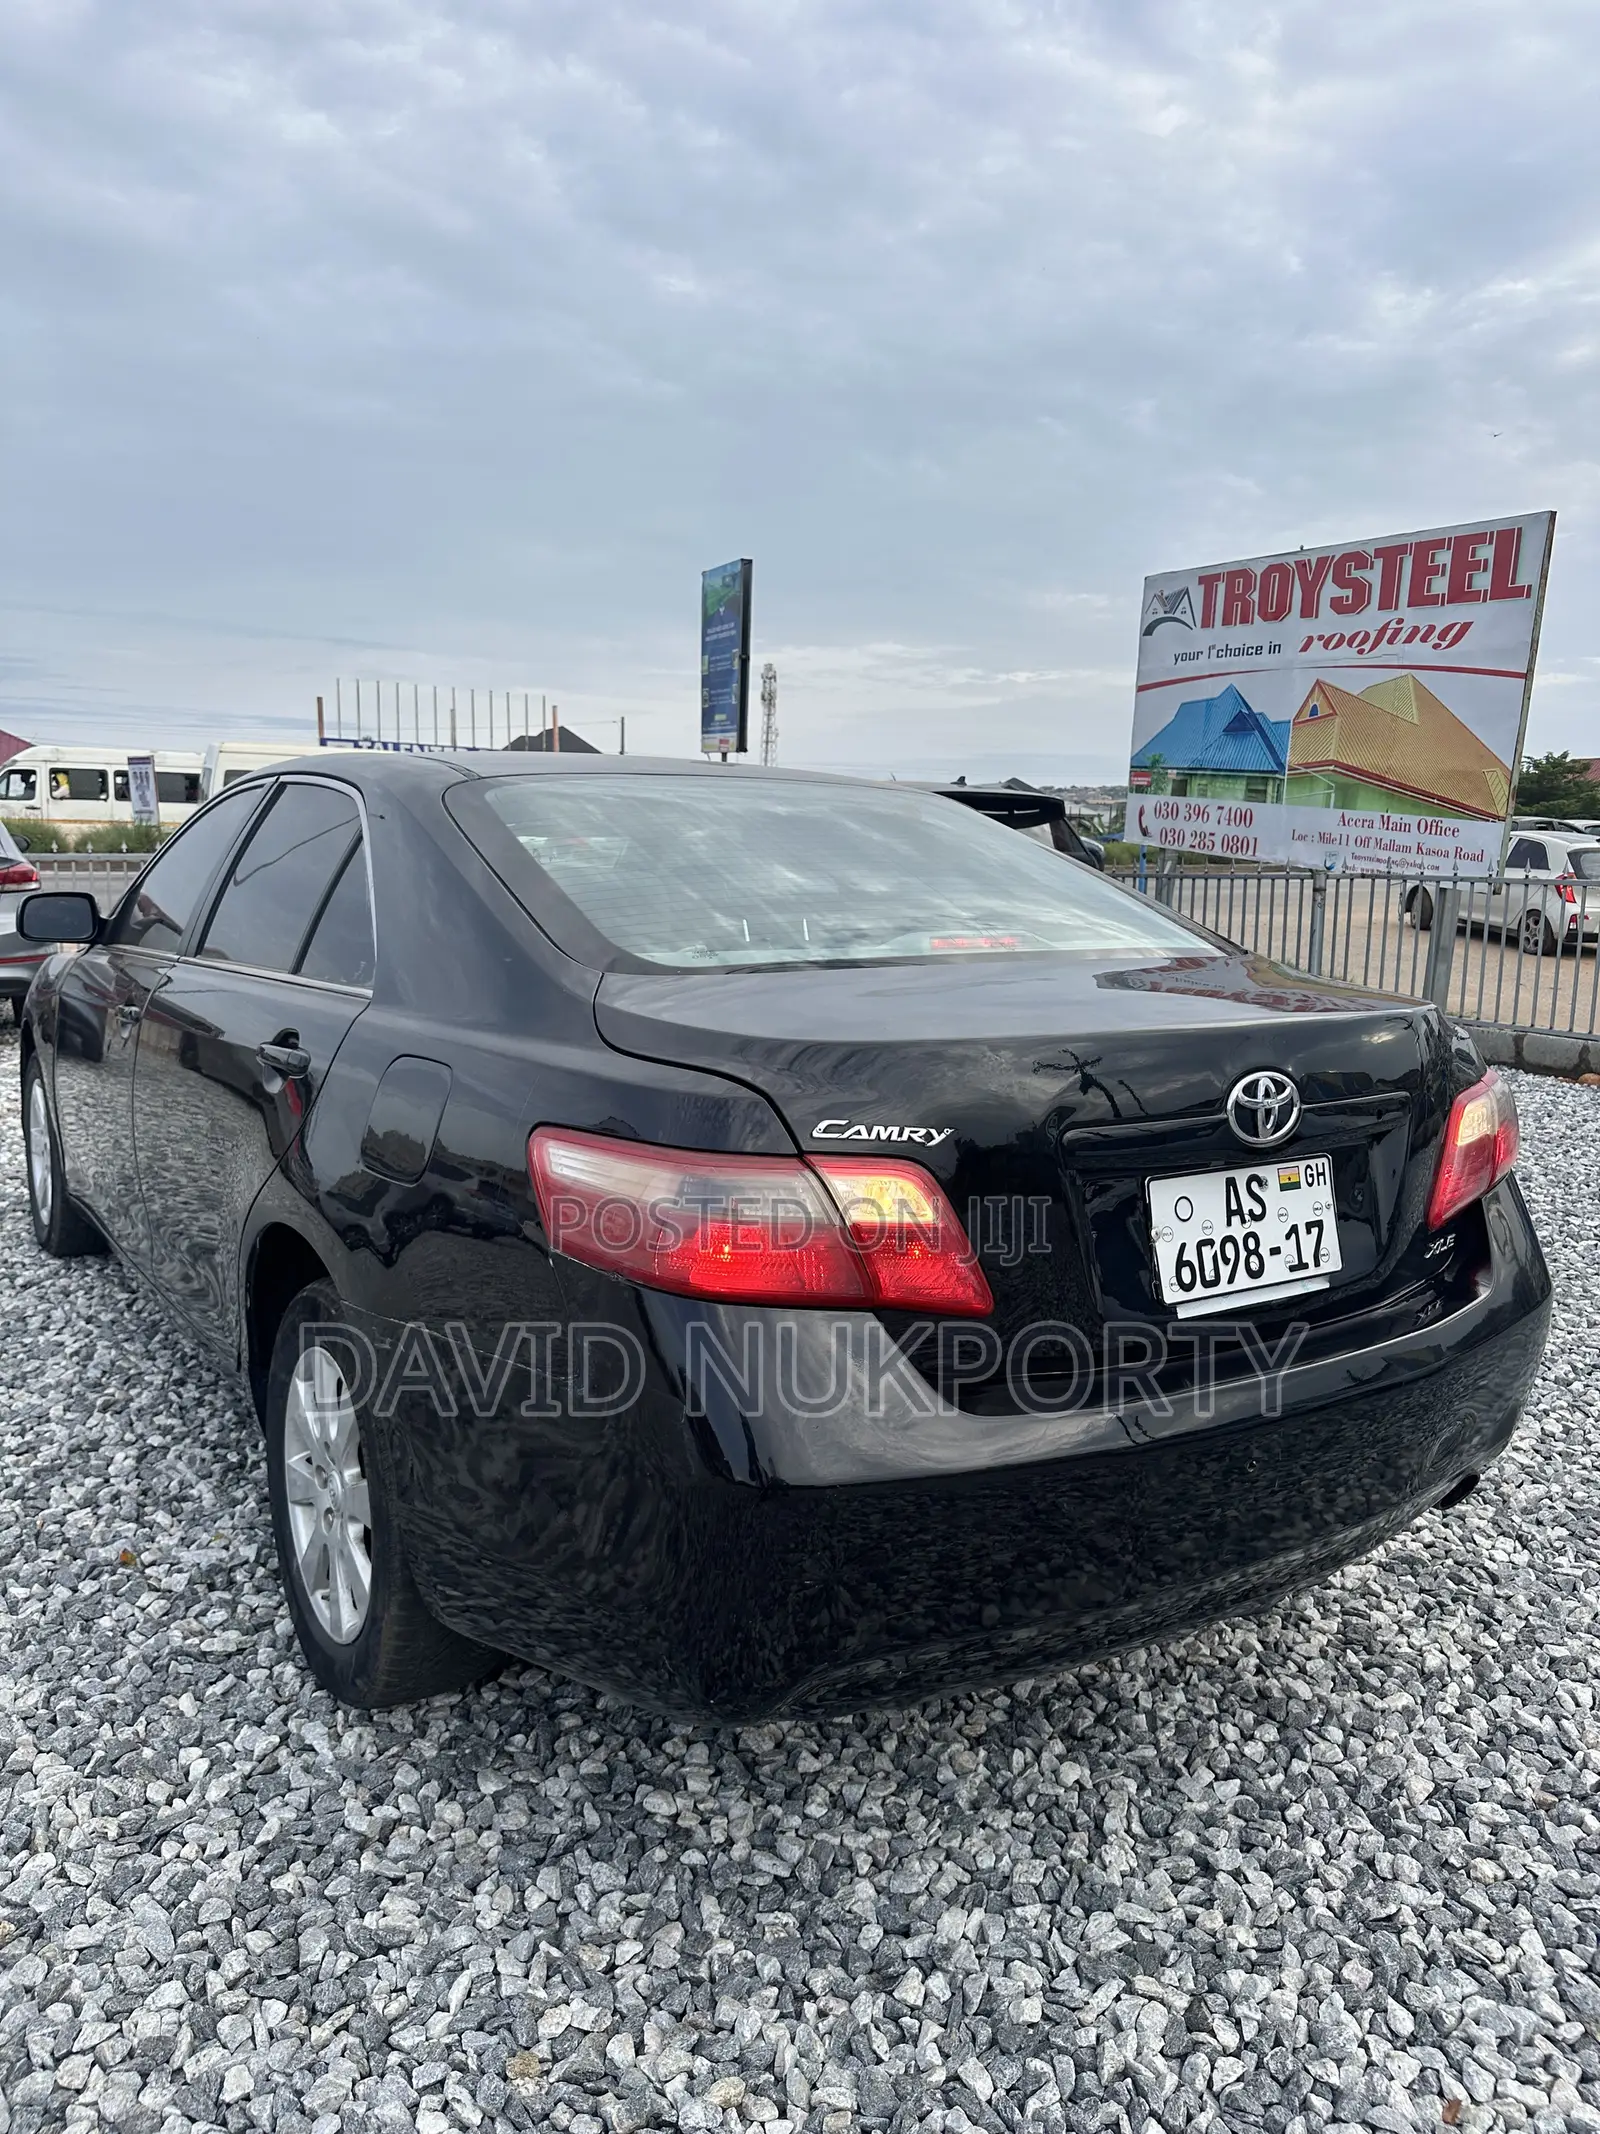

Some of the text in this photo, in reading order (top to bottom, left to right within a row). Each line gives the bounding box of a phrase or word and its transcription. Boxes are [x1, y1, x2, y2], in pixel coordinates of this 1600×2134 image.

[1197, 527, 1533, 629] TROYSTEEL
[1173, 650, 1204, 666] your
[1216, 643, 1264, 659] choice
[1267, 640, 1282, 655] in
[1299, 617, 1474, 655] roofing
[1153, 800, 1254, 829] 030 396 7400
[1336, 811, 1461, 838] Accra Main Office
[1159, 826, 1259, 857] 030 285 0801
[1291, 829, 1309, 843] Loc
[1354, 835, 1371, 849] Off
[1373, 837, 1412, 855] Mallam
[1415, 842, 1450, 859] Kasoa
[1453, 846, 1485, 863] Road
[811, 1118, 956, 1147] CAMRY
[1224, 1162, 1327, 1228] AS GH
[1175, 1219, 1325, 1293] 6098-17
[1424, 1233, 1456, 1259] XLE
